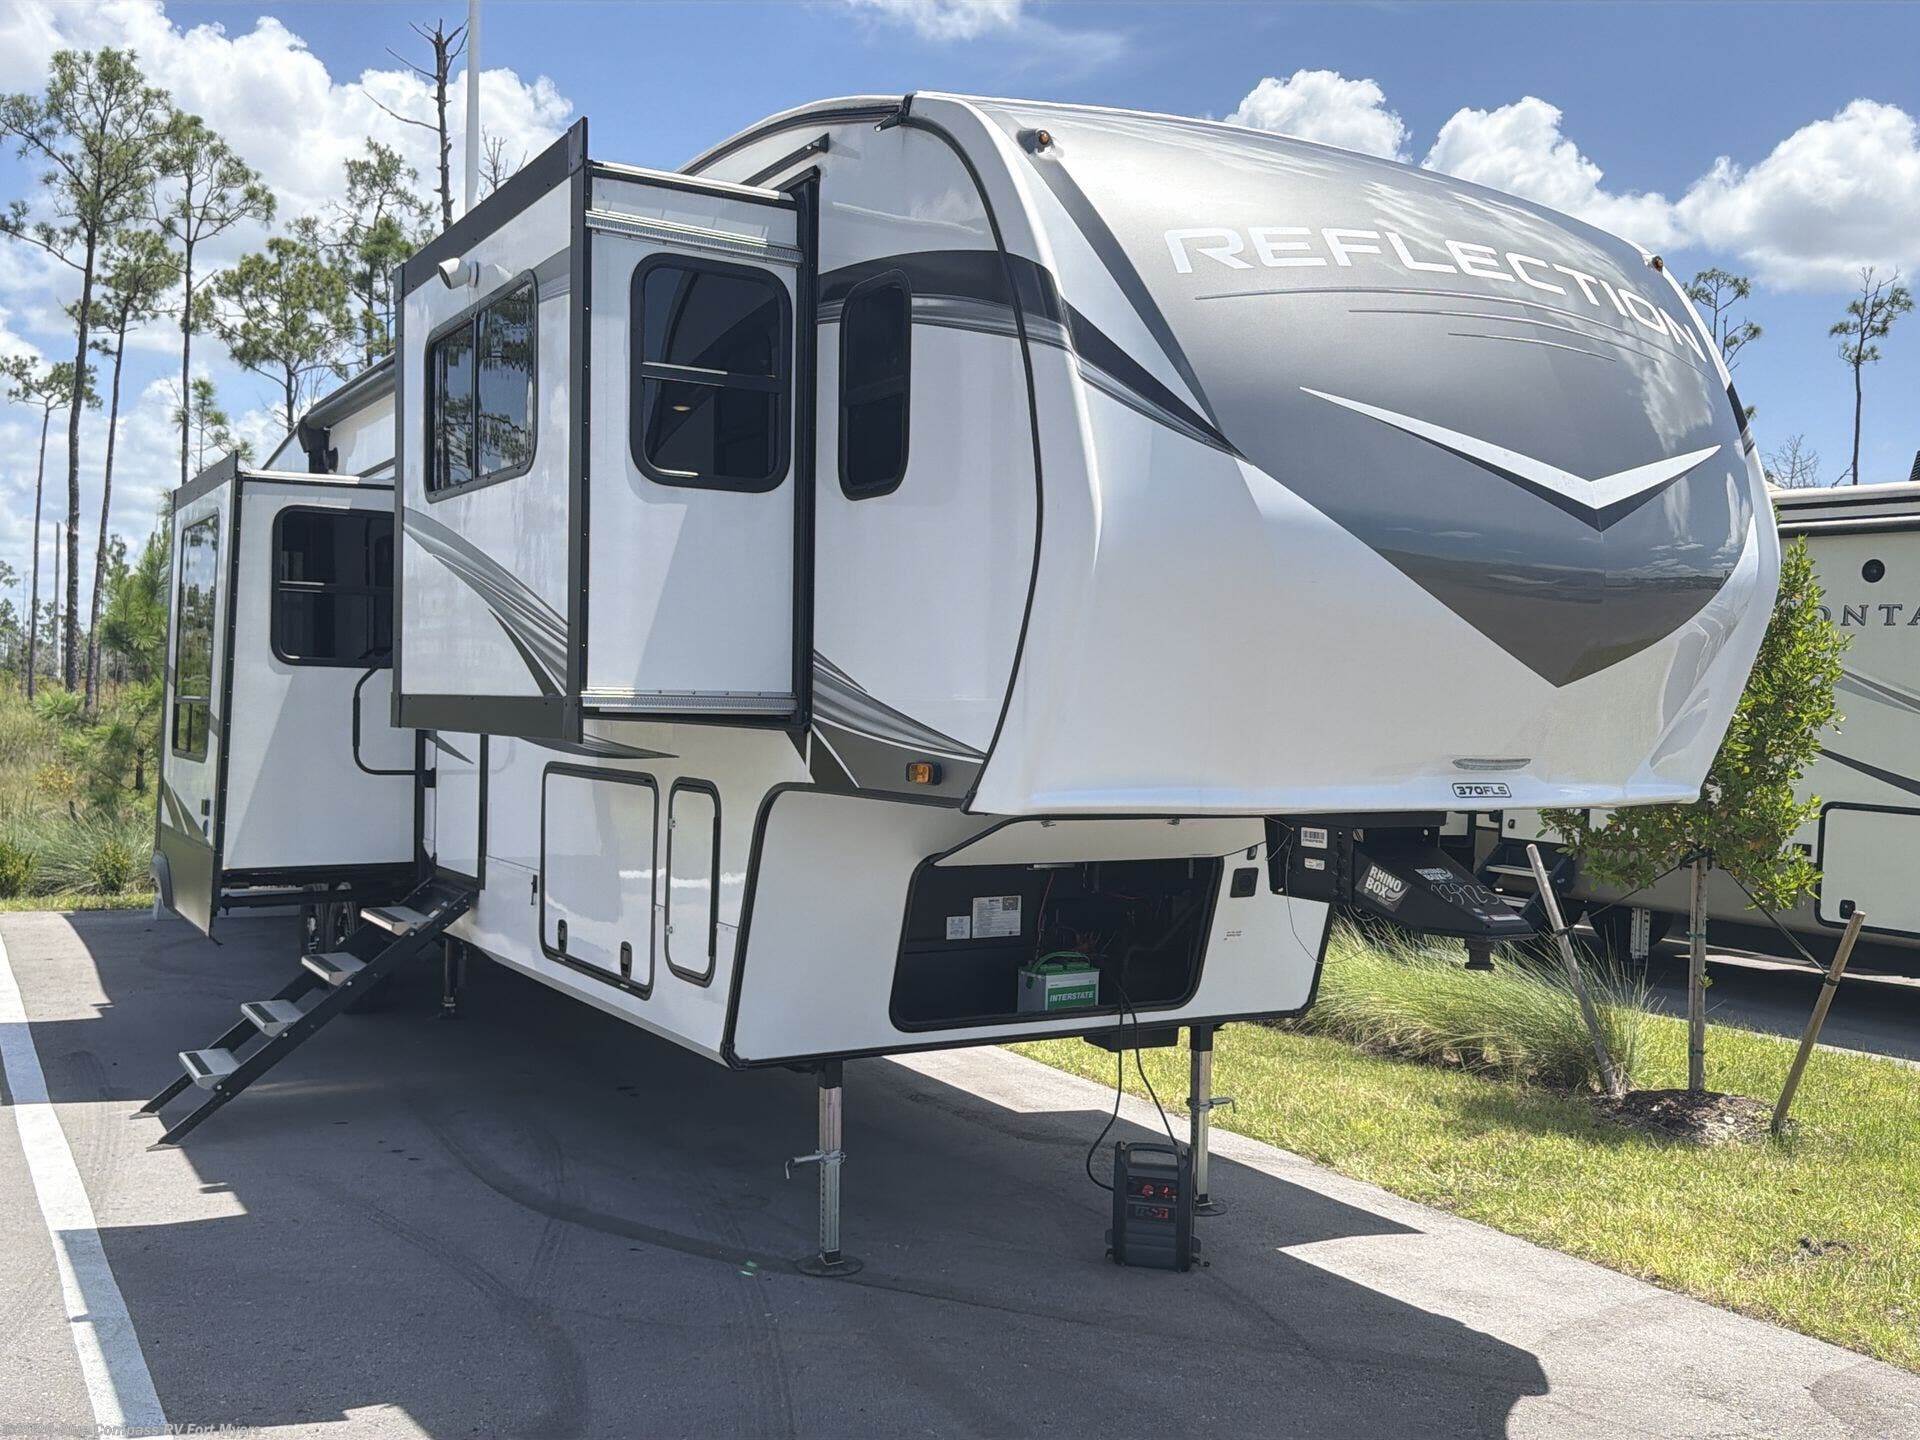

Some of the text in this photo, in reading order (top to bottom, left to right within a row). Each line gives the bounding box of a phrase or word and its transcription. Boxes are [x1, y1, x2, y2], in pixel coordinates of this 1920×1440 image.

[1163, 227, 1708, 363] REFLECTION
[1456, 786, 1508, 795] 370FLS
[1365, 876, 1389, 898] BOX
[1369, 865, 1402, 892] RHINO
[1049, 991, 1095, 1002] INTERSTATE
